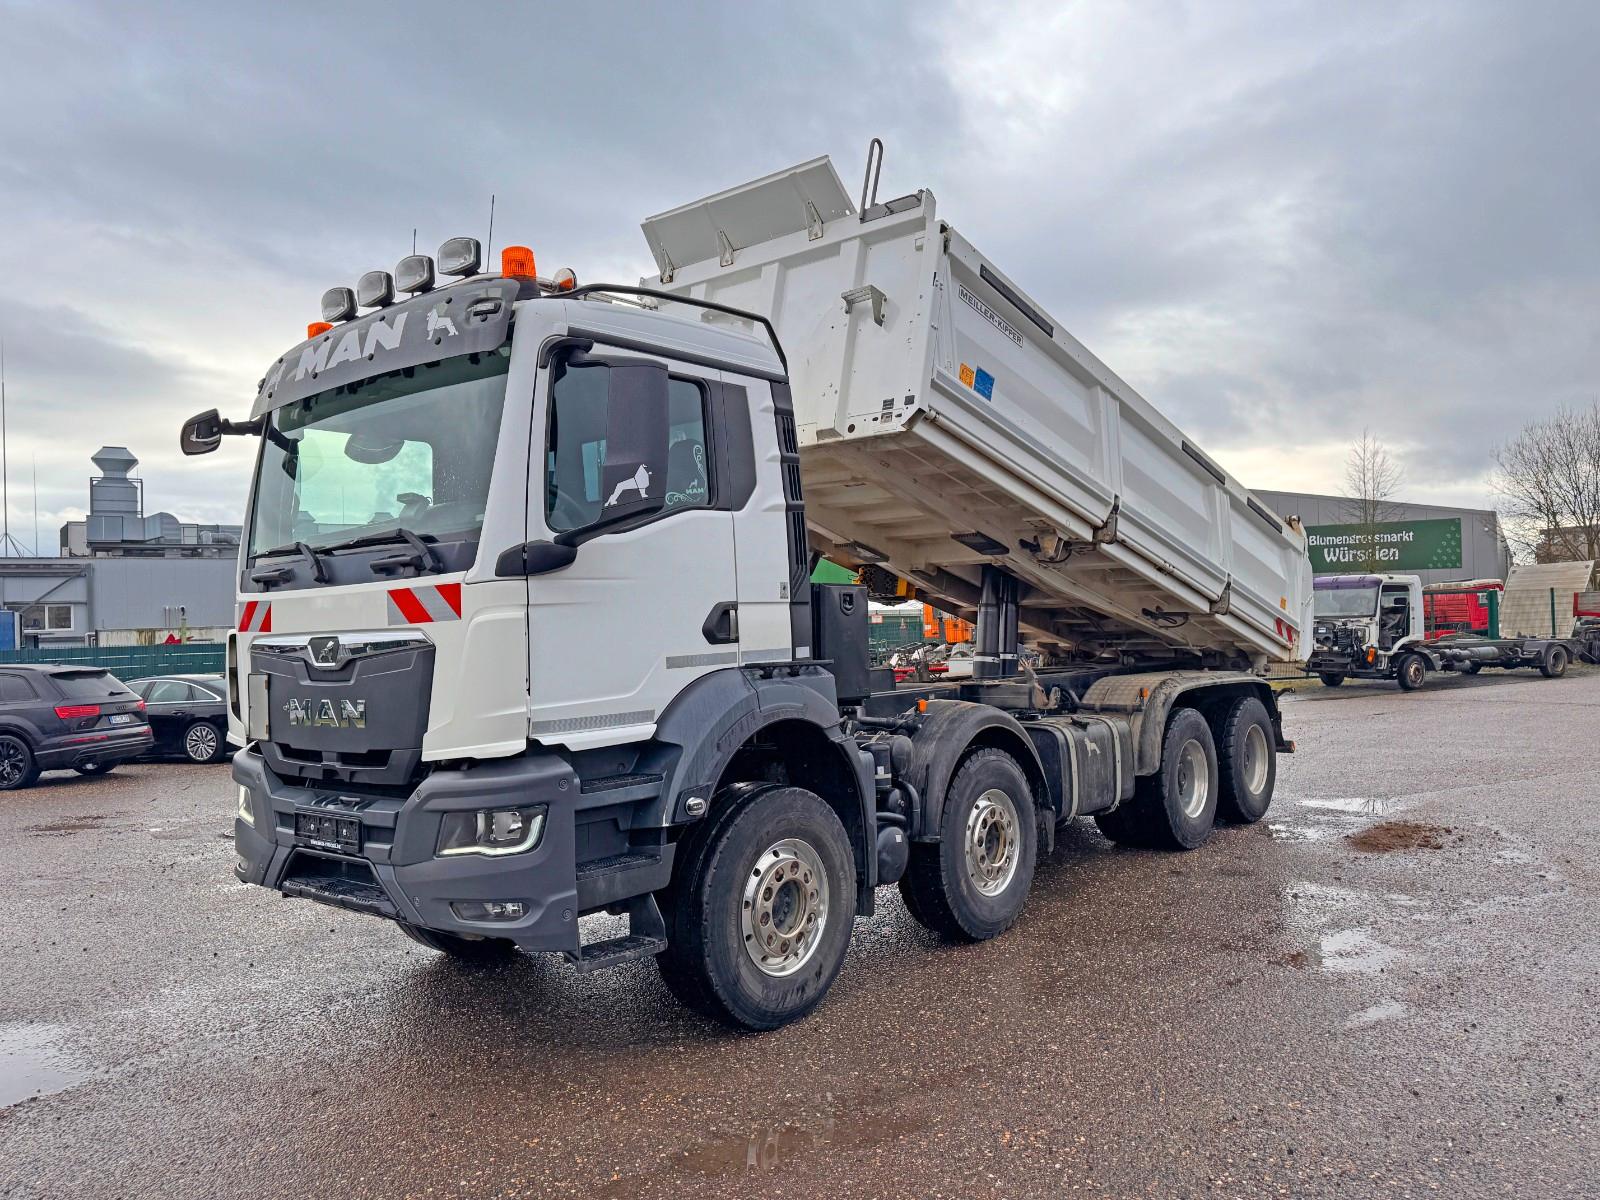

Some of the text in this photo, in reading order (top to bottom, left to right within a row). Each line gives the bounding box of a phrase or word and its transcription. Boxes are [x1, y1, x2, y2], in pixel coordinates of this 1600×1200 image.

[960, 288, 1022, 344] MEILLER-KIPPER
[295, 312, 408, 382] MAN
[289, 698, 366, 728] MAN
